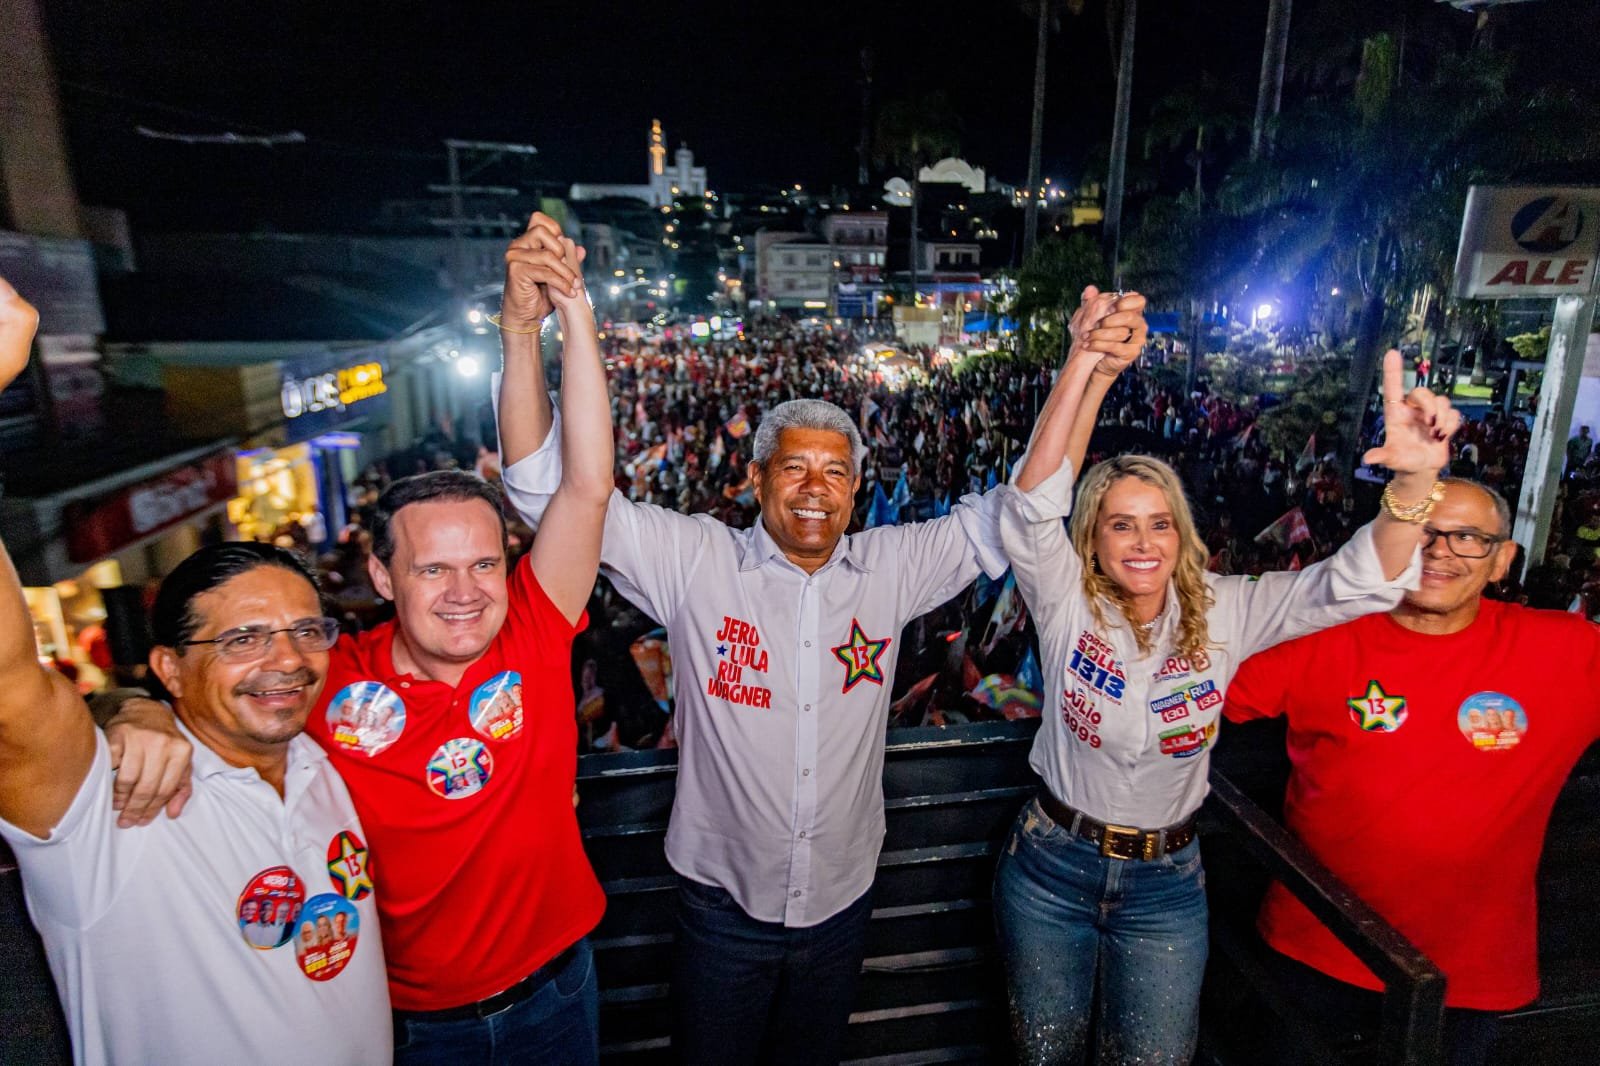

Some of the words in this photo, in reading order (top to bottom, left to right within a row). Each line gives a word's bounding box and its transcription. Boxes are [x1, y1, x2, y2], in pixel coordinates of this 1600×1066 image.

[1486, 260, 1589, 286] ALE
[716, 616, 760, 647] JERO
[730, 645, 769, 673] LULA
[850, 645, 871, 670] 13
[717, 660, 743, 684] RUI
[1069, 649, 1126, 700] 1313
[707, 677, 772, 709] WAGNER
[1151, 693, 1185, 712] WAGNER
[1190, 681, 1211, 699] RUI
[1199, 692, 1219, 709] 133
[1367, 697, 1386, 716] 13
[1060, 703, 1102, 749] 3999
[343, 852, 362, 878] 13
